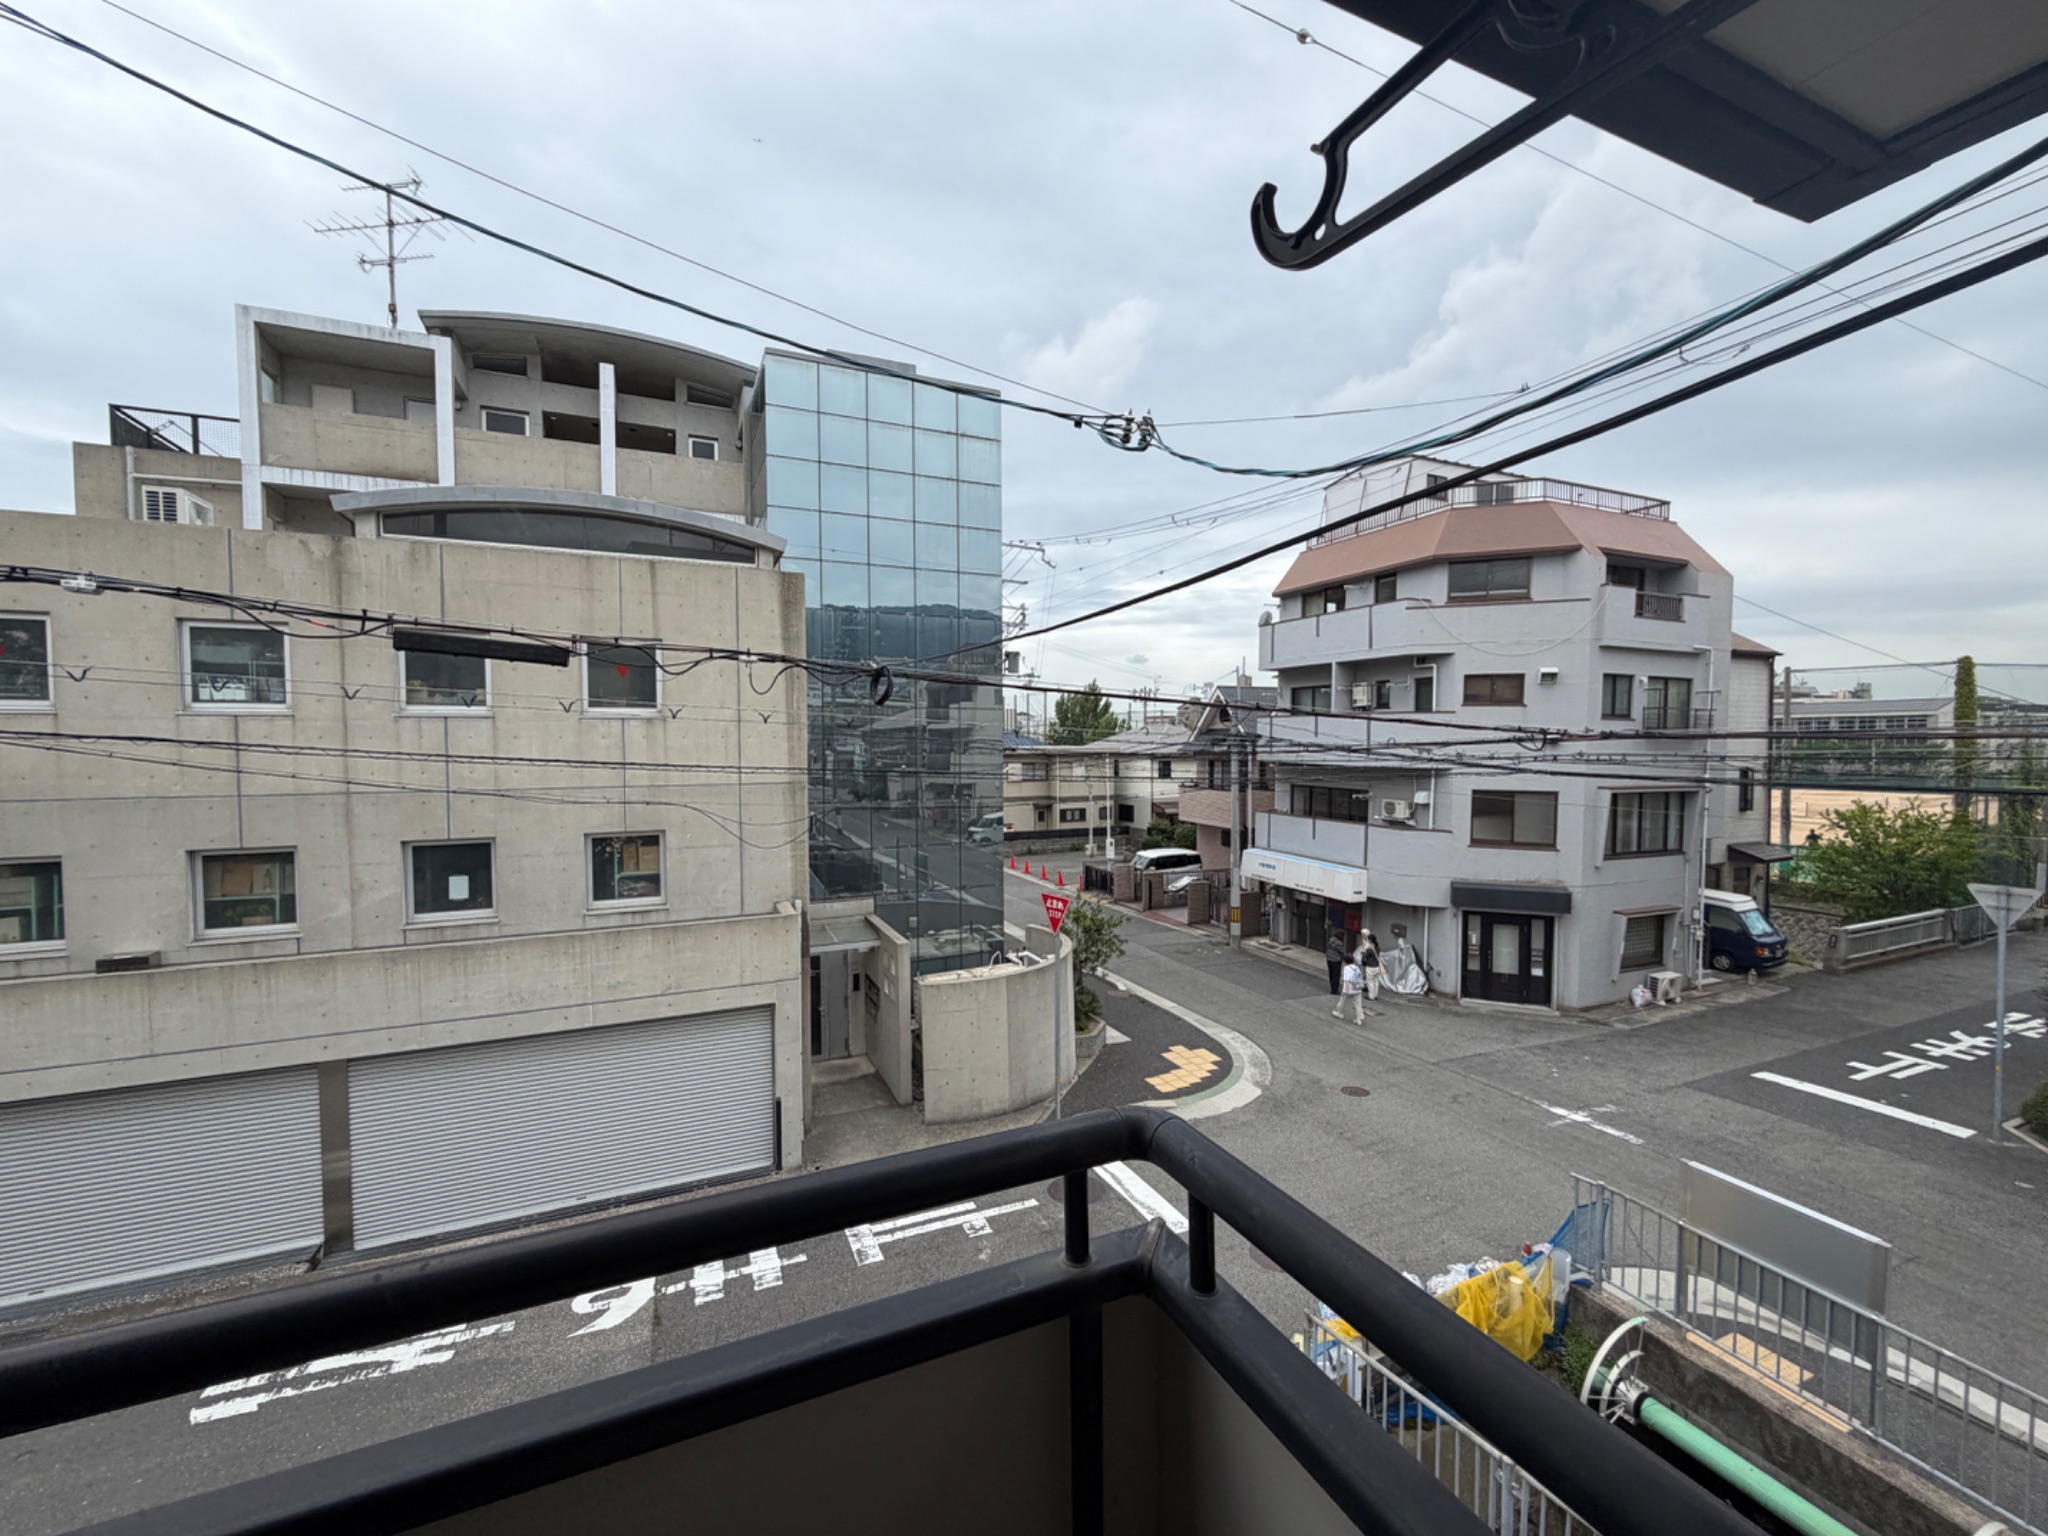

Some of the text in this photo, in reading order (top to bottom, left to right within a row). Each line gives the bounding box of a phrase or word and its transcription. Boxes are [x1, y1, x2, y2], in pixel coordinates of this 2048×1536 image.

[1046, 897, 1065, 910] 止まれ
[1048, 909, 1062, 919] STOP
